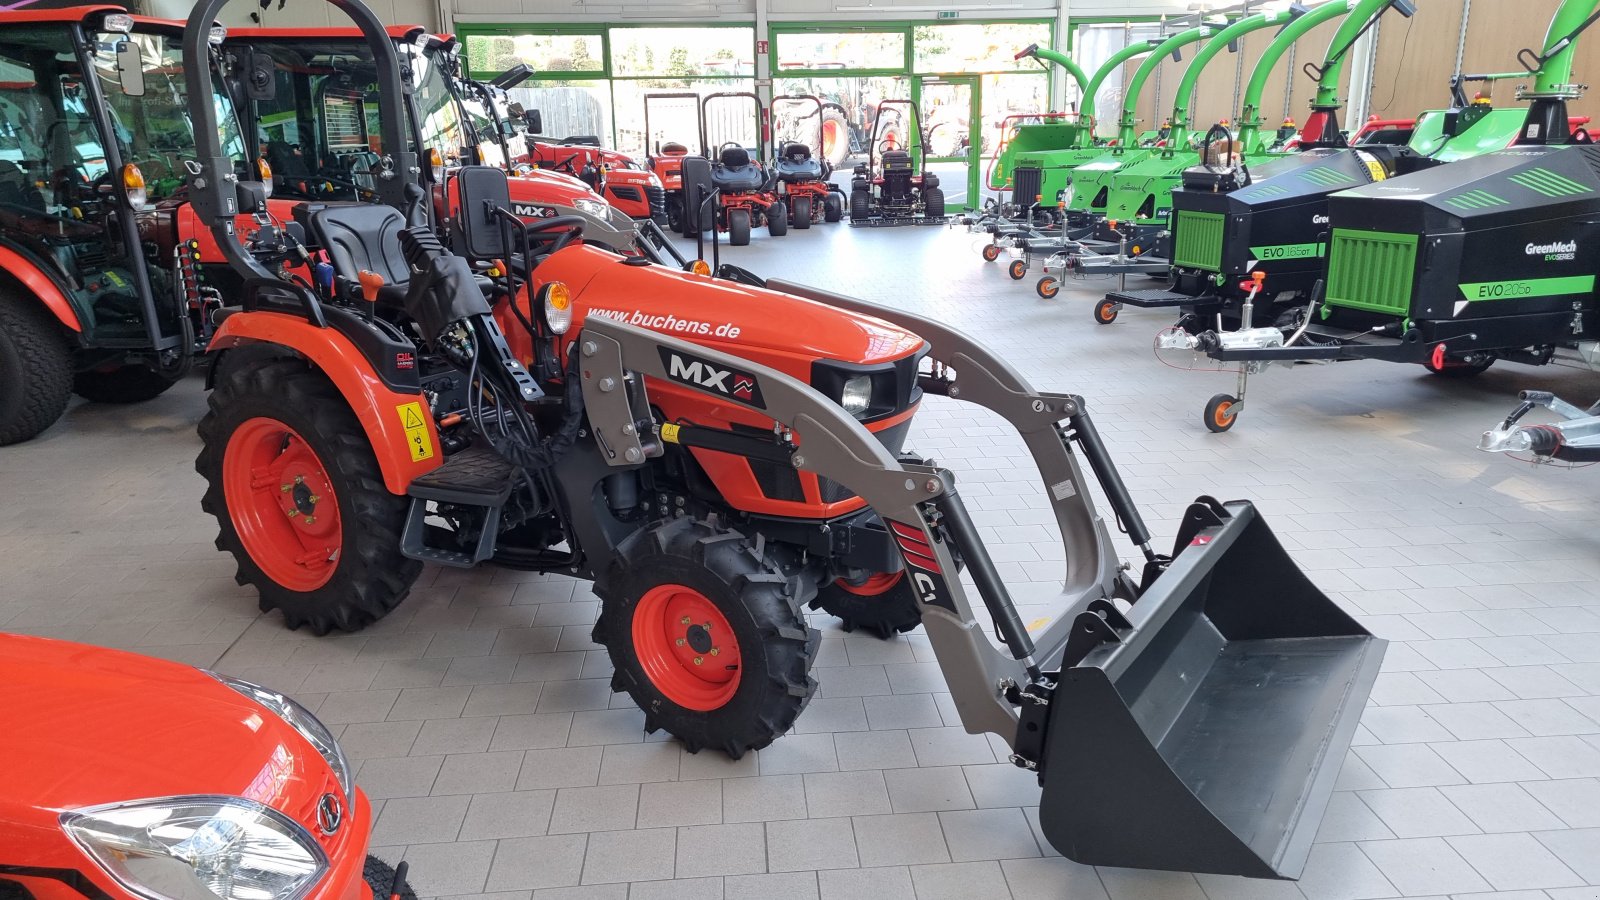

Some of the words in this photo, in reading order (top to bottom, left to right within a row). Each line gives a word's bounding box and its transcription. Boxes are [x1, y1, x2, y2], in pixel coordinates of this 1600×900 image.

[515, 204, 545, 218] MX
[1263, 247, 1285, 258] EVO
[1525, 239, 1577, 255] GreenMech
[1478, 284, 1504, 297] EVO
[587, 307, 741, 339] www.buchens.de
[669, 353, 731, 393] MX
[914, 572, 937, 602] C1
